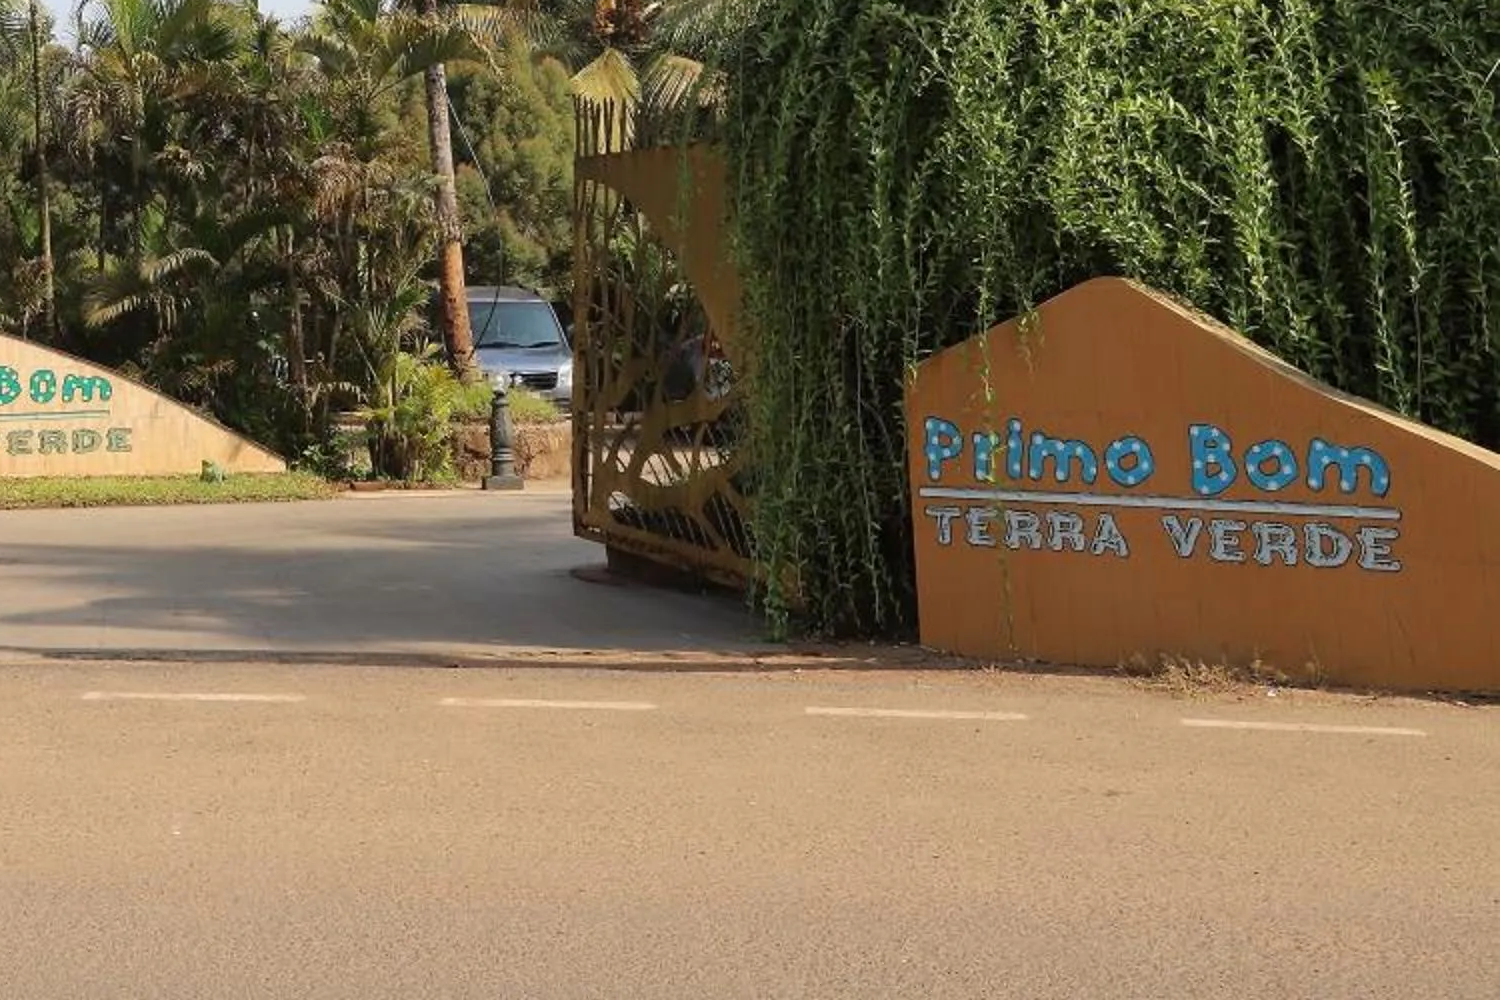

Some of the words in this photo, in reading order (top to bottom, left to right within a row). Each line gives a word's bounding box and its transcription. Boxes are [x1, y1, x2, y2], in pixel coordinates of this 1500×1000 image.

[924, 416, 1155, 487] Primo
[1188, 423, 1391, 498] Bom
[925, 505, 1130, 558] TERRA
[1163, 515, 1402, 572] VERDE
